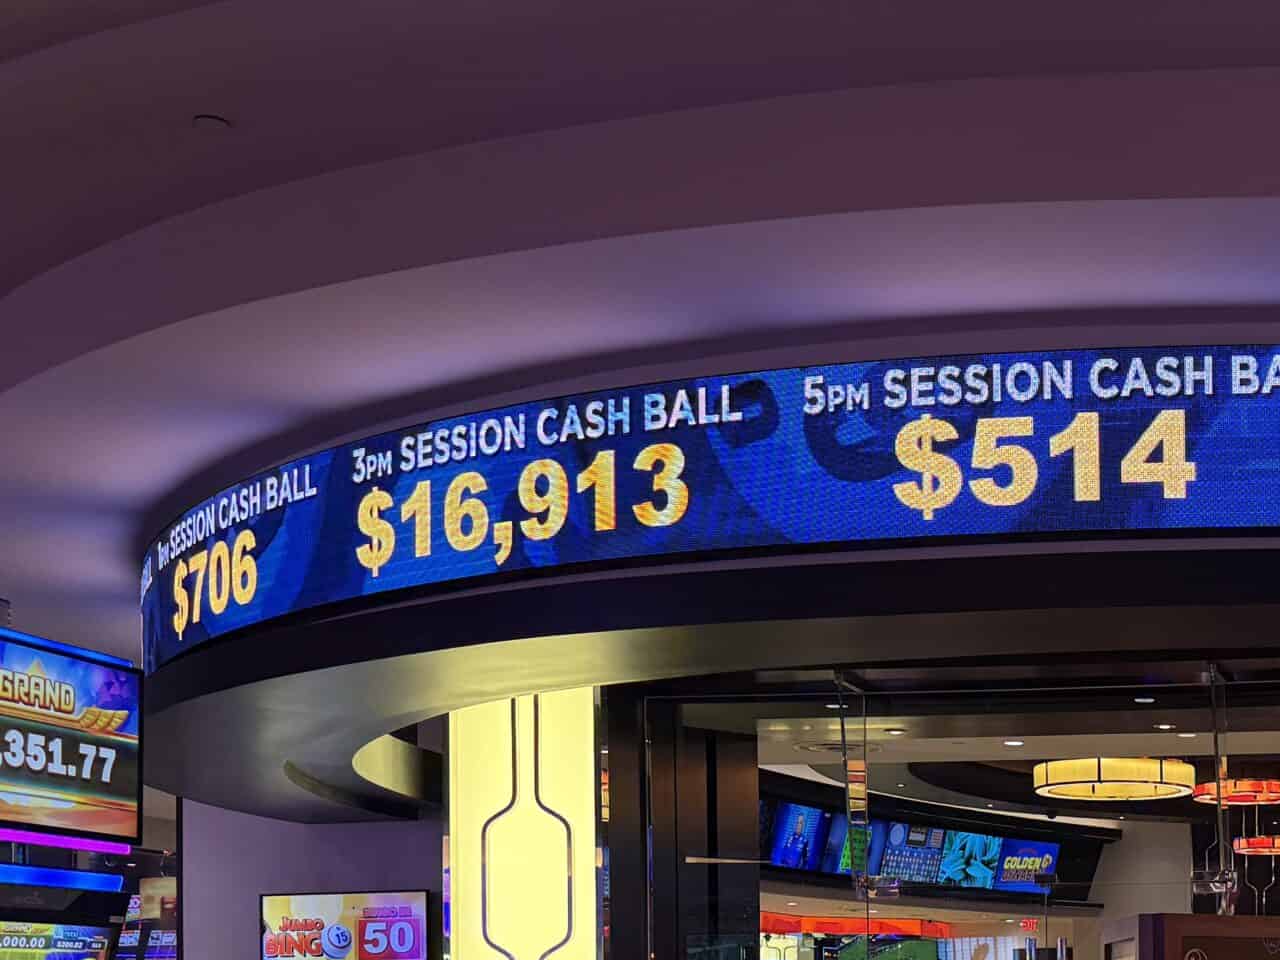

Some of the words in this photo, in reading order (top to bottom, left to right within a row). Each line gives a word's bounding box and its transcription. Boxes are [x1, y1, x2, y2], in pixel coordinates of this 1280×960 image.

[803, 375, 869, 416] 5PM
[883, 358, 1073, 409] SESSION
[1089, 355, 1214, 399] CASH
[352, 446, 393, 484] 3PM
[400, 412, 526, 473] SESSION
[536, 396, 630, 449] CASH
[644, 384, 743, 430] BALL
[893, 408, 1197, 520] $514
[170, 503, 215, 559] SESSION
[219, 482, 260, 529] CASH
[266, 464, 317, 510] BALL
[355, 442, 690, 578] $16,913
[174, 529, 257, 640] $706
[0, 669, 75, 714] GRAND
[279, 916, 324, 932] JUMBO
[364, 922, 414, 954] 50
